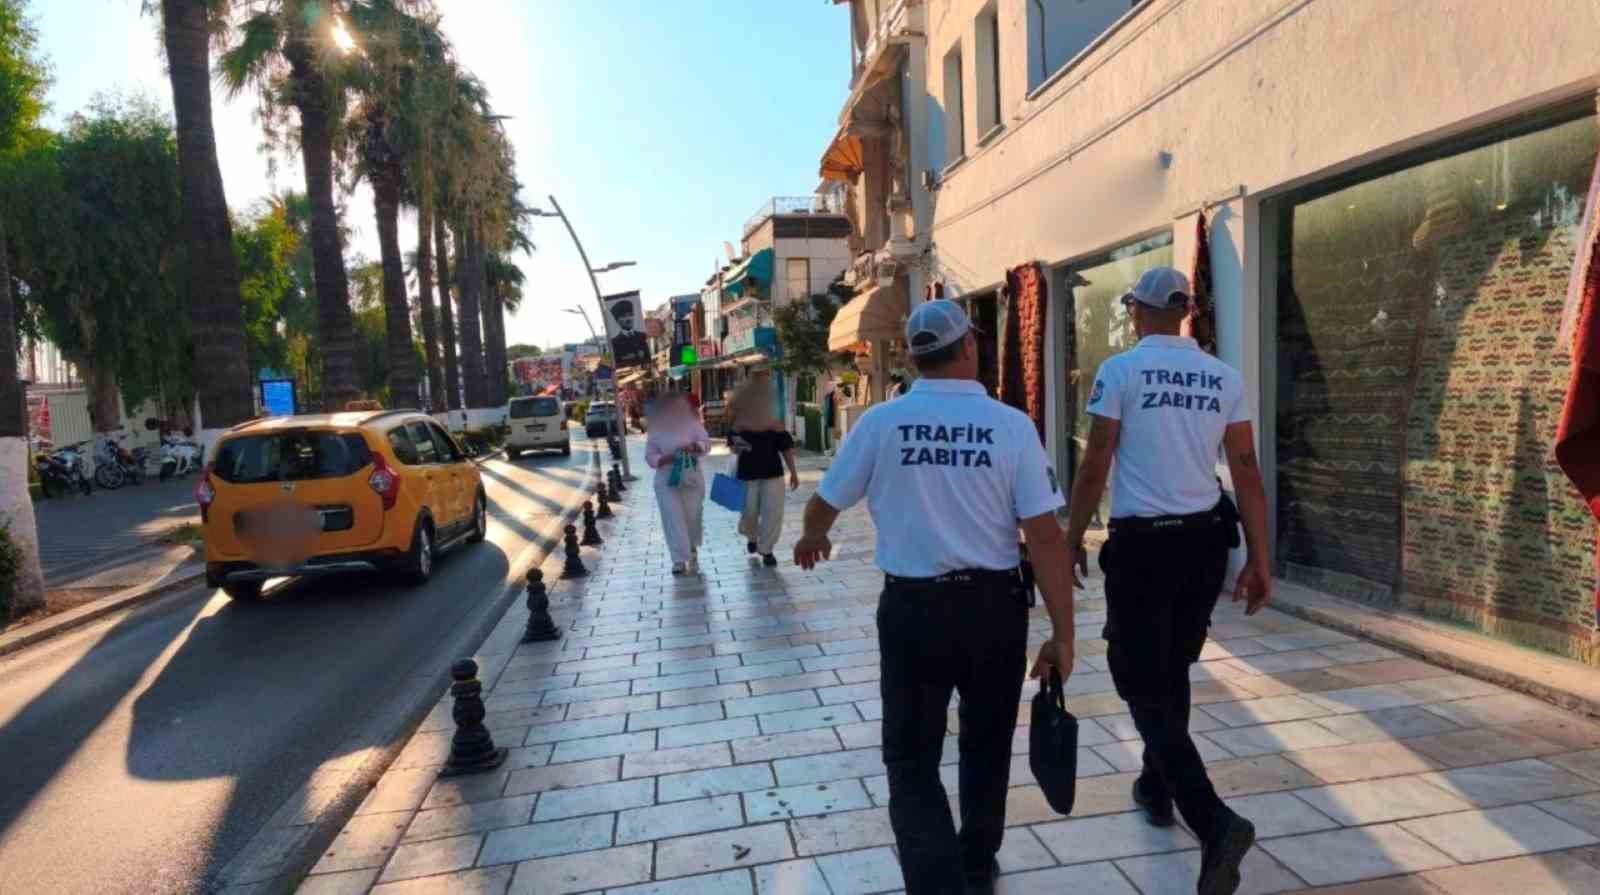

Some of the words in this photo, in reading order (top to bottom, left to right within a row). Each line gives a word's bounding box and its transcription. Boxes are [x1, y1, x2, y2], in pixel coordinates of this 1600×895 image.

[1141, 369, 1223, 391] TRAFİK
[1141, 391, 1221, 413] ZABITA
[898, 422, 995, 445] TRAFİK
[900, 447, 992, 468] ZABITA
